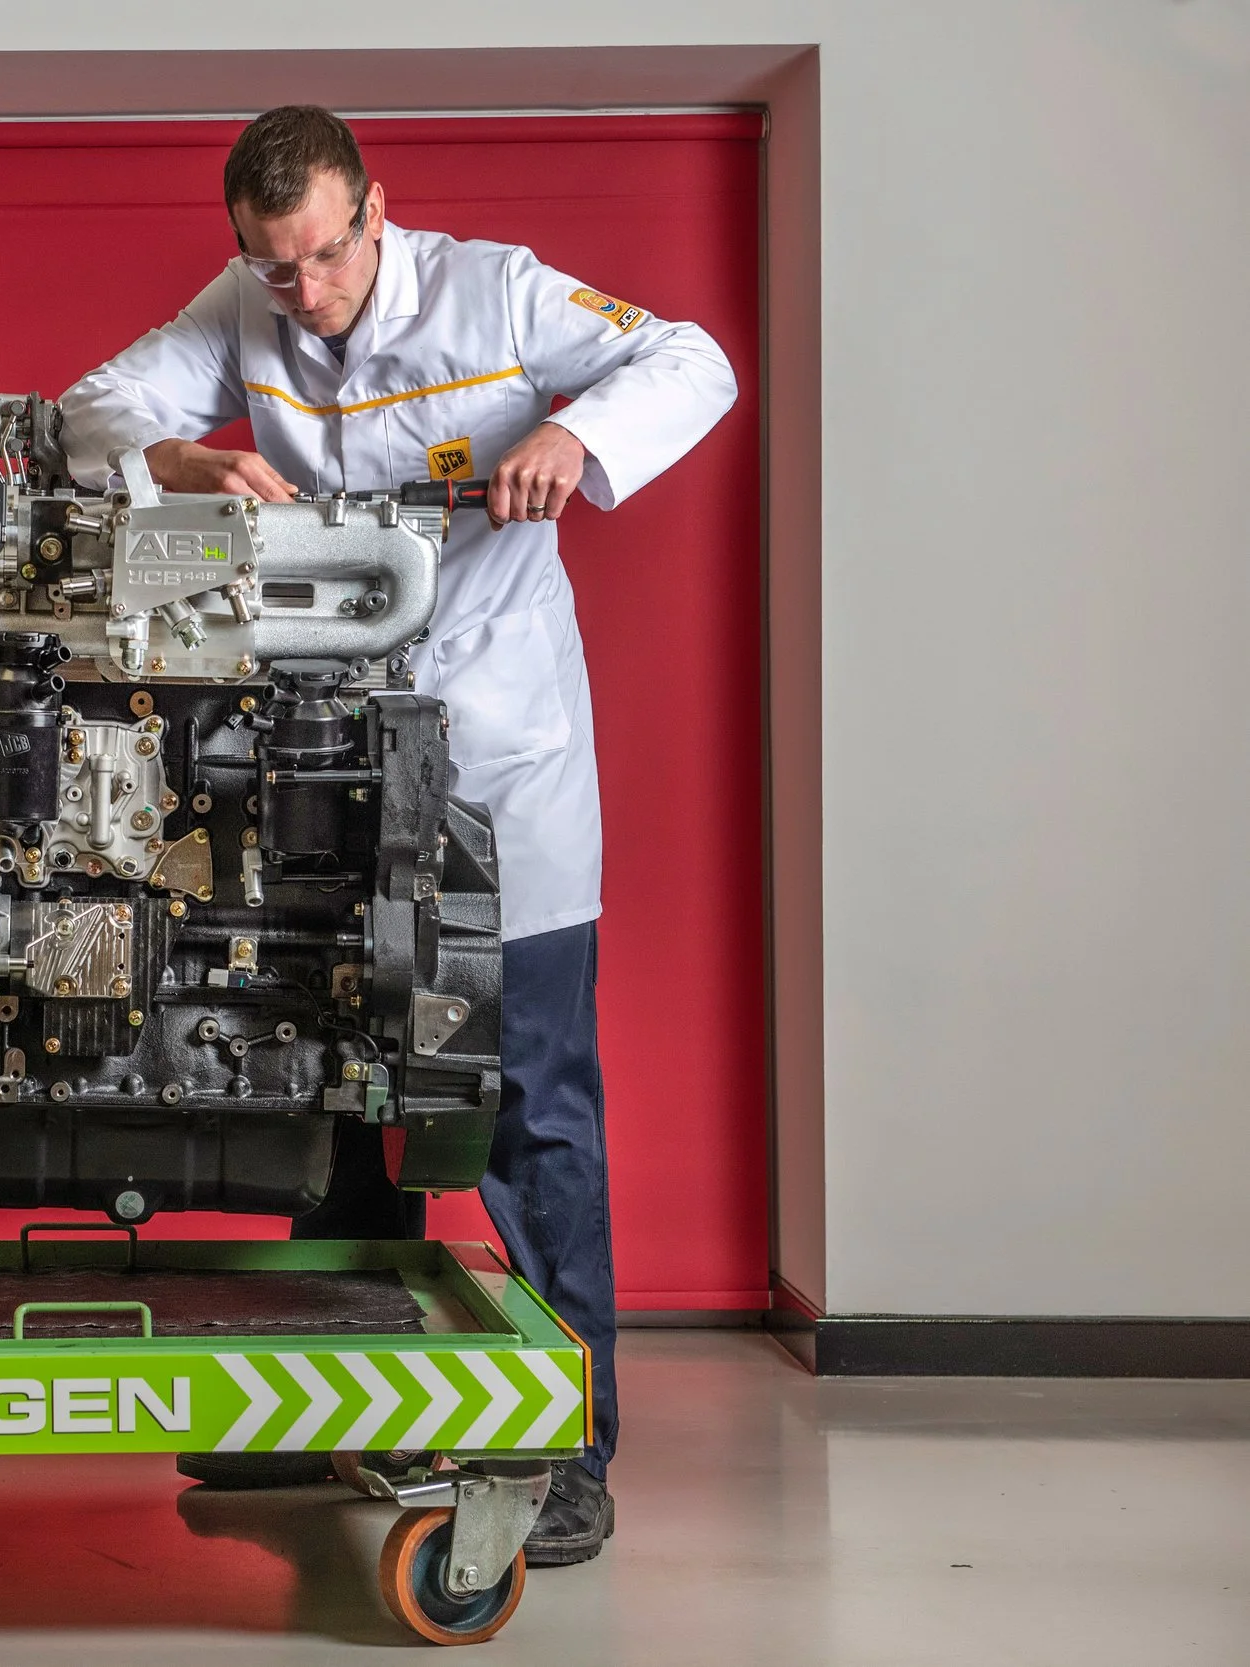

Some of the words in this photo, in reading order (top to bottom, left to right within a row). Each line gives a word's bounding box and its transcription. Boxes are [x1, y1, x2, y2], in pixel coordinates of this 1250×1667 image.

[619, 307, 639, 329] JCB
[438, 451, 465, 473] JCB
[129, 569, 182, 585] JCB
[4, 734, 29, 754] JCB
